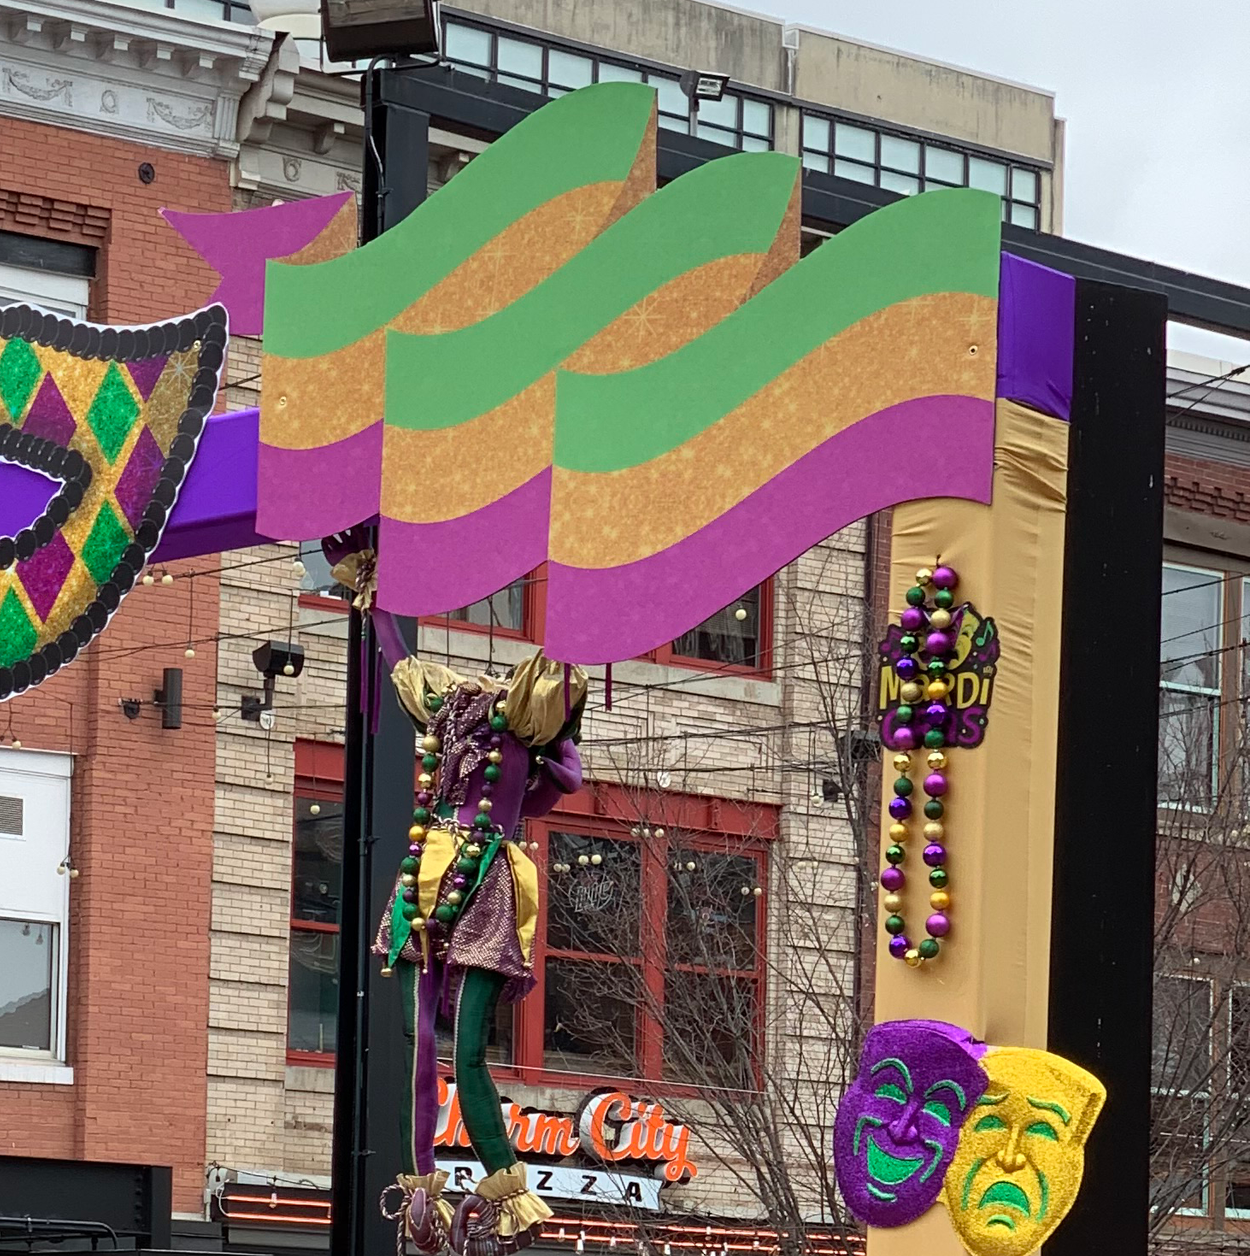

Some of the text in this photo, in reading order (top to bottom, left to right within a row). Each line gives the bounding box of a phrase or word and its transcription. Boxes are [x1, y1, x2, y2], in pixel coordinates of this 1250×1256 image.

[433, 1076, 697, 1182] hrm City
[454, 1166, 642, 1203] PZZA
